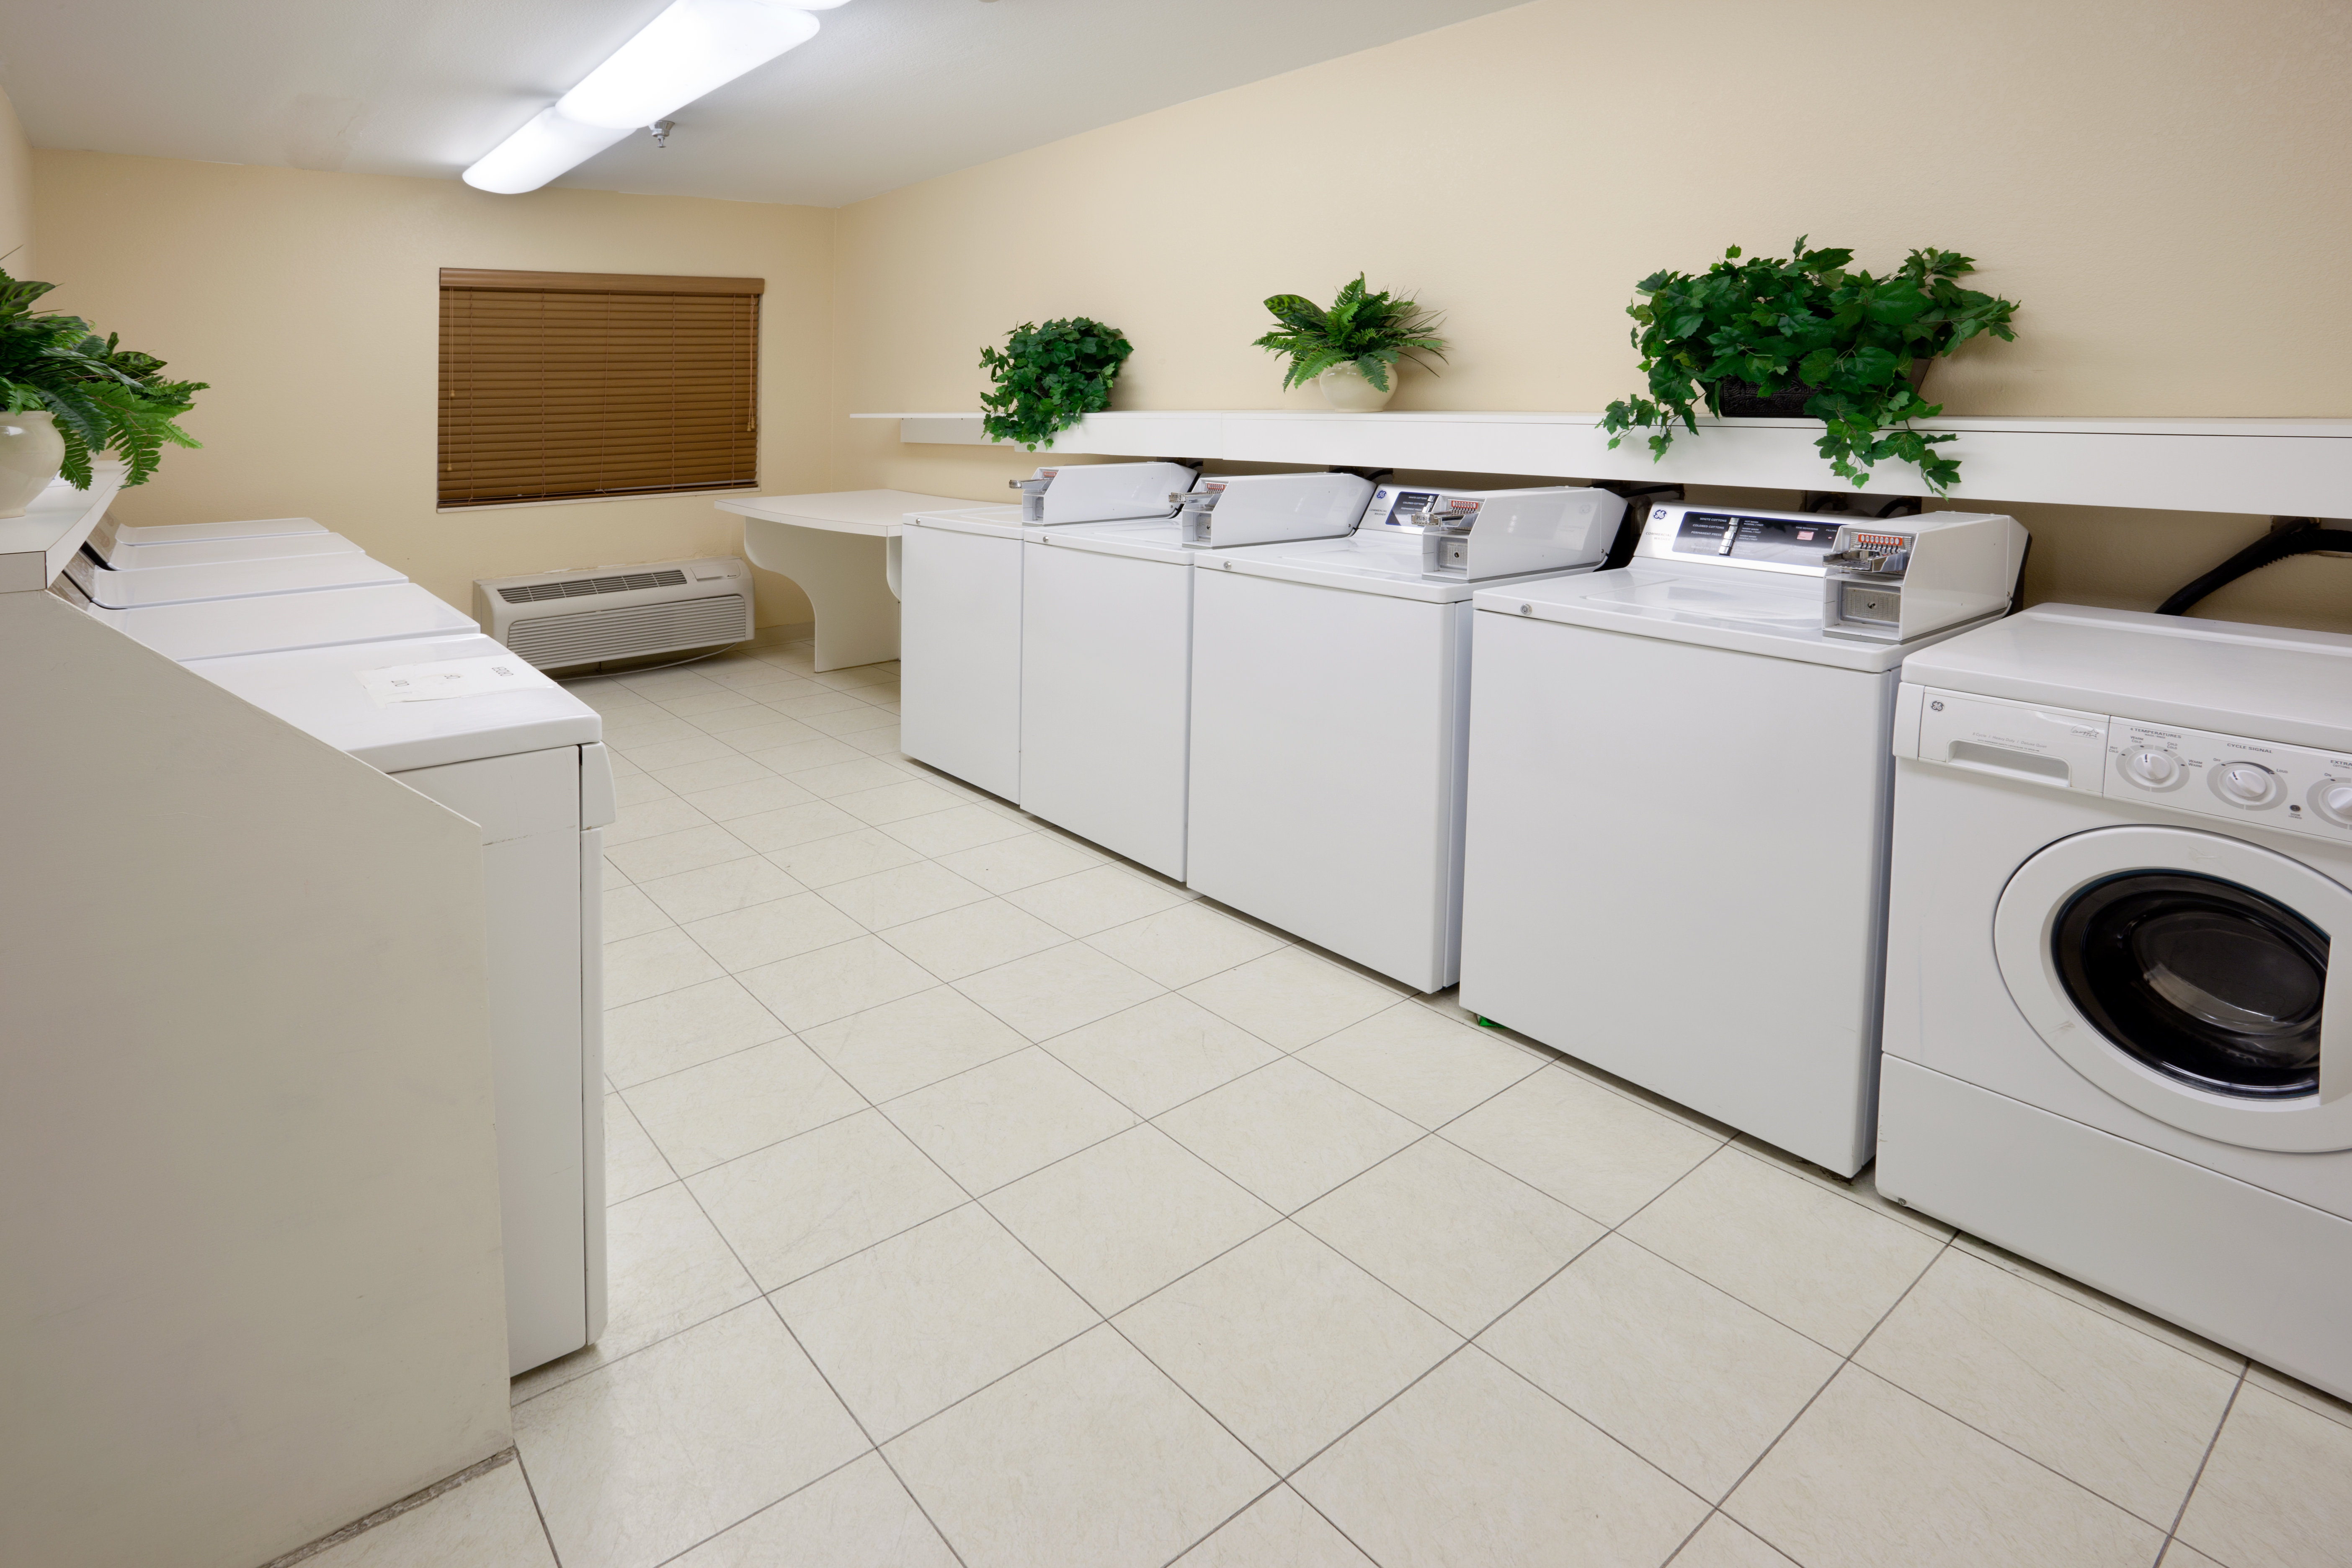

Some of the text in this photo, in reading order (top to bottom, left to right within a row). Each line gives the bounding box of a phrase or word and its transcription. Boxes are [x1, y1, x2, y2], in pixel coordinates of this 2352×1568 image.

[1653, 509, 1667, 520] GE
[1930, 700, 1945, 712] GE
[2135, 728, 2182, 739] TEMPERATURES
